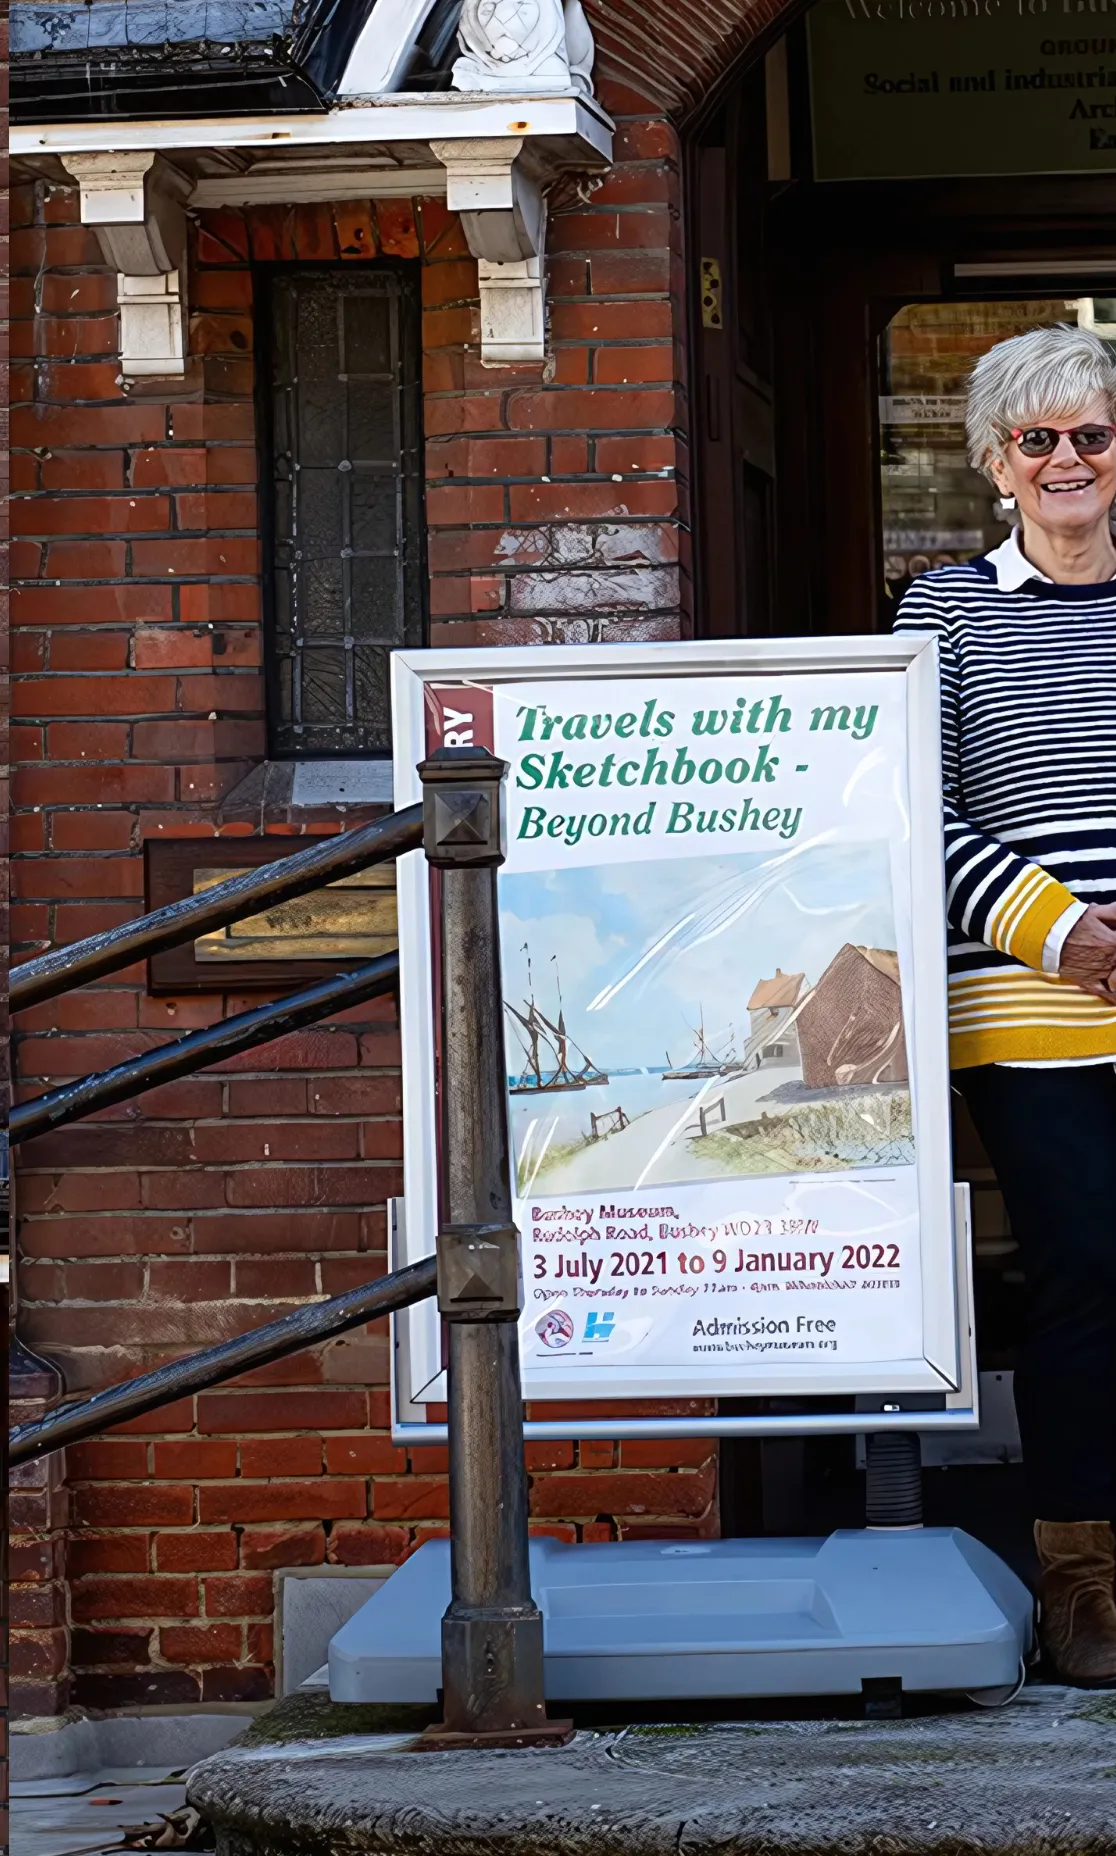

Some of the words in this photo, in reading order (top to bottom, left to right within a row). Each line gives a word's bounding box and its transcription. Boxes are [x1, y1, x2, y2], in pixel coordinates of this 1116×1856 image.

[863, 71, 939, 96] Social
[949, 69, 995, 92] and
[515, 698, 675, 744] Travels
[691, 695, 792, 735] with
[809, 702, 879, 741] my
[515, 745, 779, 791] Sketchbook
[516, 801, 656, 846] Beyond
[665, 796, 804, 838] Bushey
[533, 1254, 547, 1279] 3
[555, 1252, 603, 1284] July
[610, 1250, 668, 1277] 2021
[678, 1251, 705, 1274] to
[712, 1248, 727, 1273] 9
[734, 1247, 834, 1277] January
[841, 1243, 901, 1269] 2022
[692, 1316, 790, 1337] Admission
[796, 1315, 837, 1333] Free
